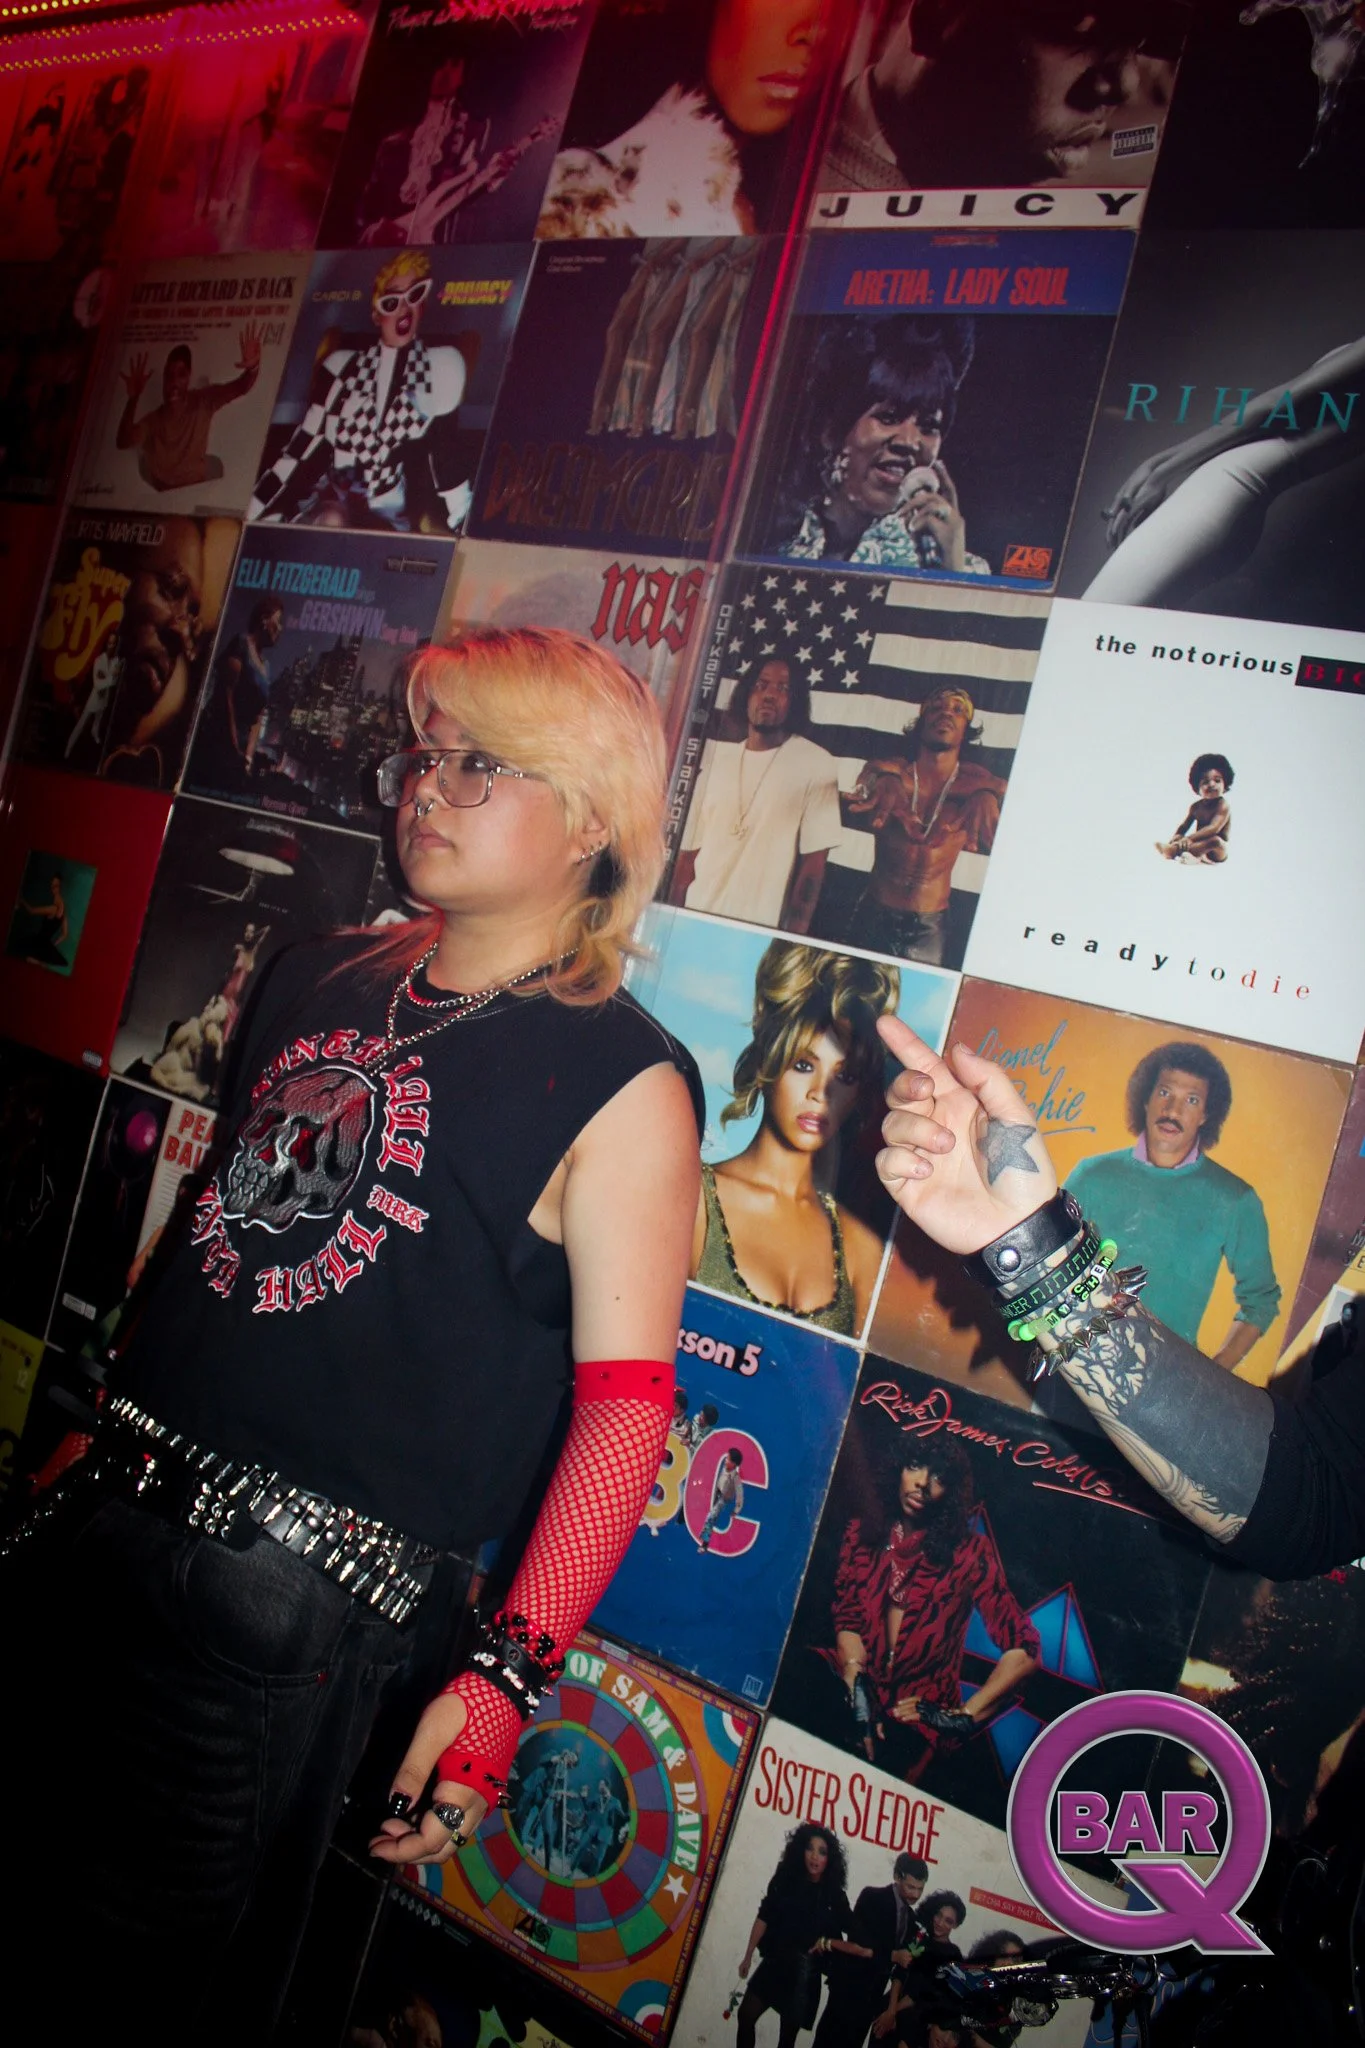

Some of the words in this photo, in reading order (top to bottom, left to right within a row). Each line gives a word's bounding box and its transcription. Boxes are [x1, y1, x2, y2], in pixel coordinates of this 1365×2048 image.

[819, 192, 1138, 219] JUICY
[131, 281, 177, 304] LITTLE
[177, 279, 239, 302] RICHARD
[239, 278, 256, 300] IS
[256, 276, 296, 299] BACK
[844, 268, 934, 306] ARETHA:
[943, 268, 1010, 305] LADY
[1008, 267, 1070, 305] SOUL
[1123, 383, 1360, 434] RIHAN
[66, 518, 105, 541] RTIS
[107, 521, 165, 547] MAYFIELD
[236, 558, 269, 590] ELLA
[270, 560, 361, 600] FITZGERALD
[300, 600, 386, 639] GERSHWIN
[1095, 634, 1137, 655] the
[1151, 644, 1294, 676] notorious
[1023, 925, 1169, 972] ready
[1188, 956, 1226, 982] to
[1240, 969, 1311, 1001] die
[1010, 1065, 1086, 1122] chie
[738, 1342, 764, 1377] 5
[860, 1379, 938, 1423] Rick
[902, 1387, 1011, 1458] James
[1013, 1440, 1082, 1484] Cold
[569, 1652, 608, 1686] OF
[611, 1673, 672, 1740] SAM
[663, 1745, 687, 1771] &
[755, 1746, 842, 1833] SISTER
[842, 1772, 945, 1865] SLEDGE
[673, 1781, 701, 1873] DAVE
